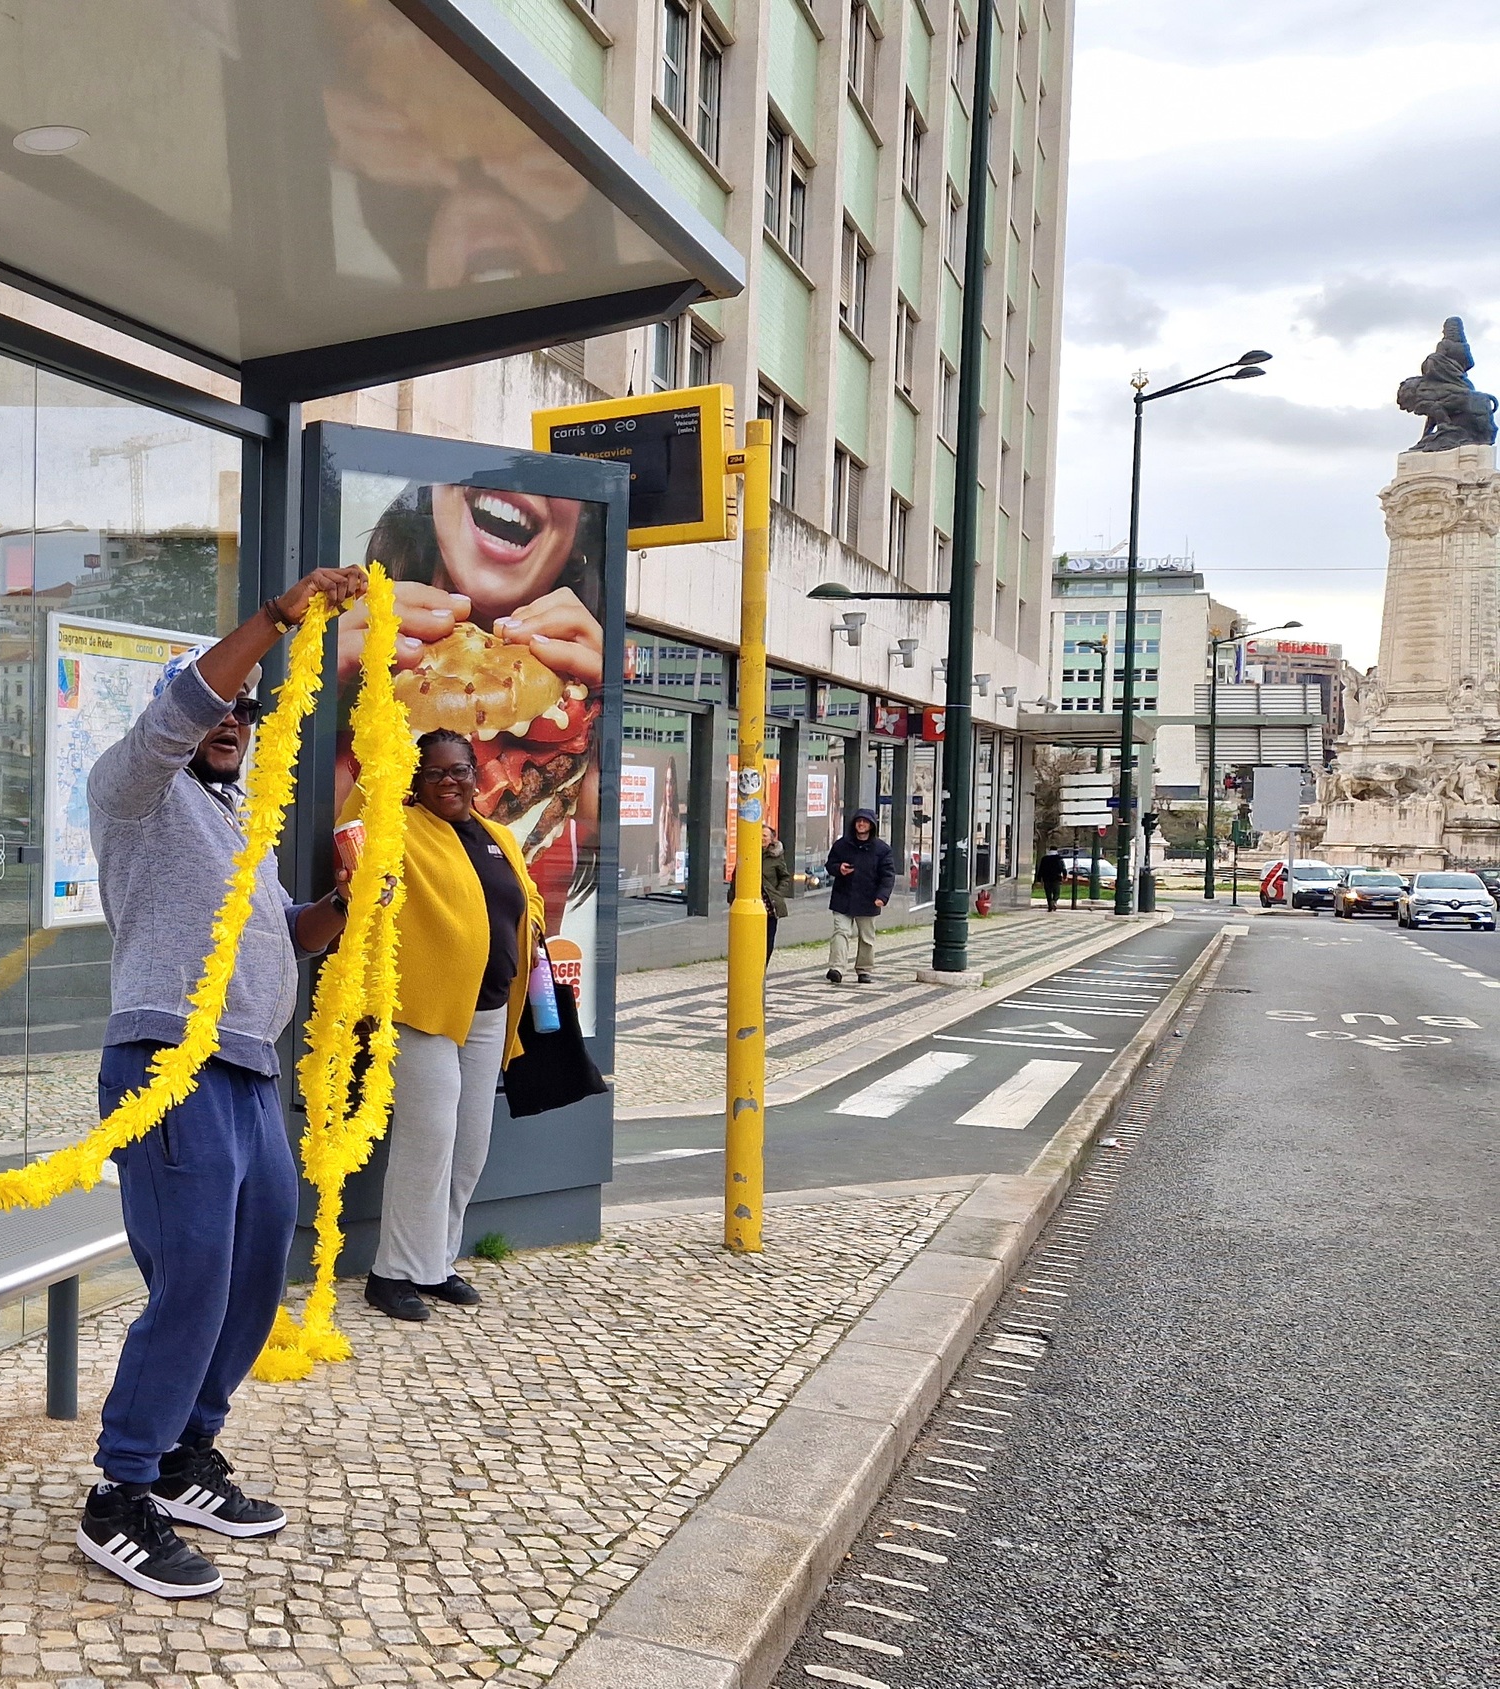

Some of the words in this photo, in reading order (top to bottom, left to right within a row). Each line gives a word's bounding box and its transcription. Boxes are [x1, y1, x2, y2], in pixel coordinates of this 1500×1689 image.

[553, 425, 586, 439] carris
[1092, 556, 1192, 577] Sanander
[58, 631, 87, 645] Diagrama
[89, 636, 96, 646] de
[97, 637, 113, 649] Rede
[635, 647, 650, 676] BPI
[551, 963, 581, 978] RGER
[1265, 1009, 1484, 1030] BUS
